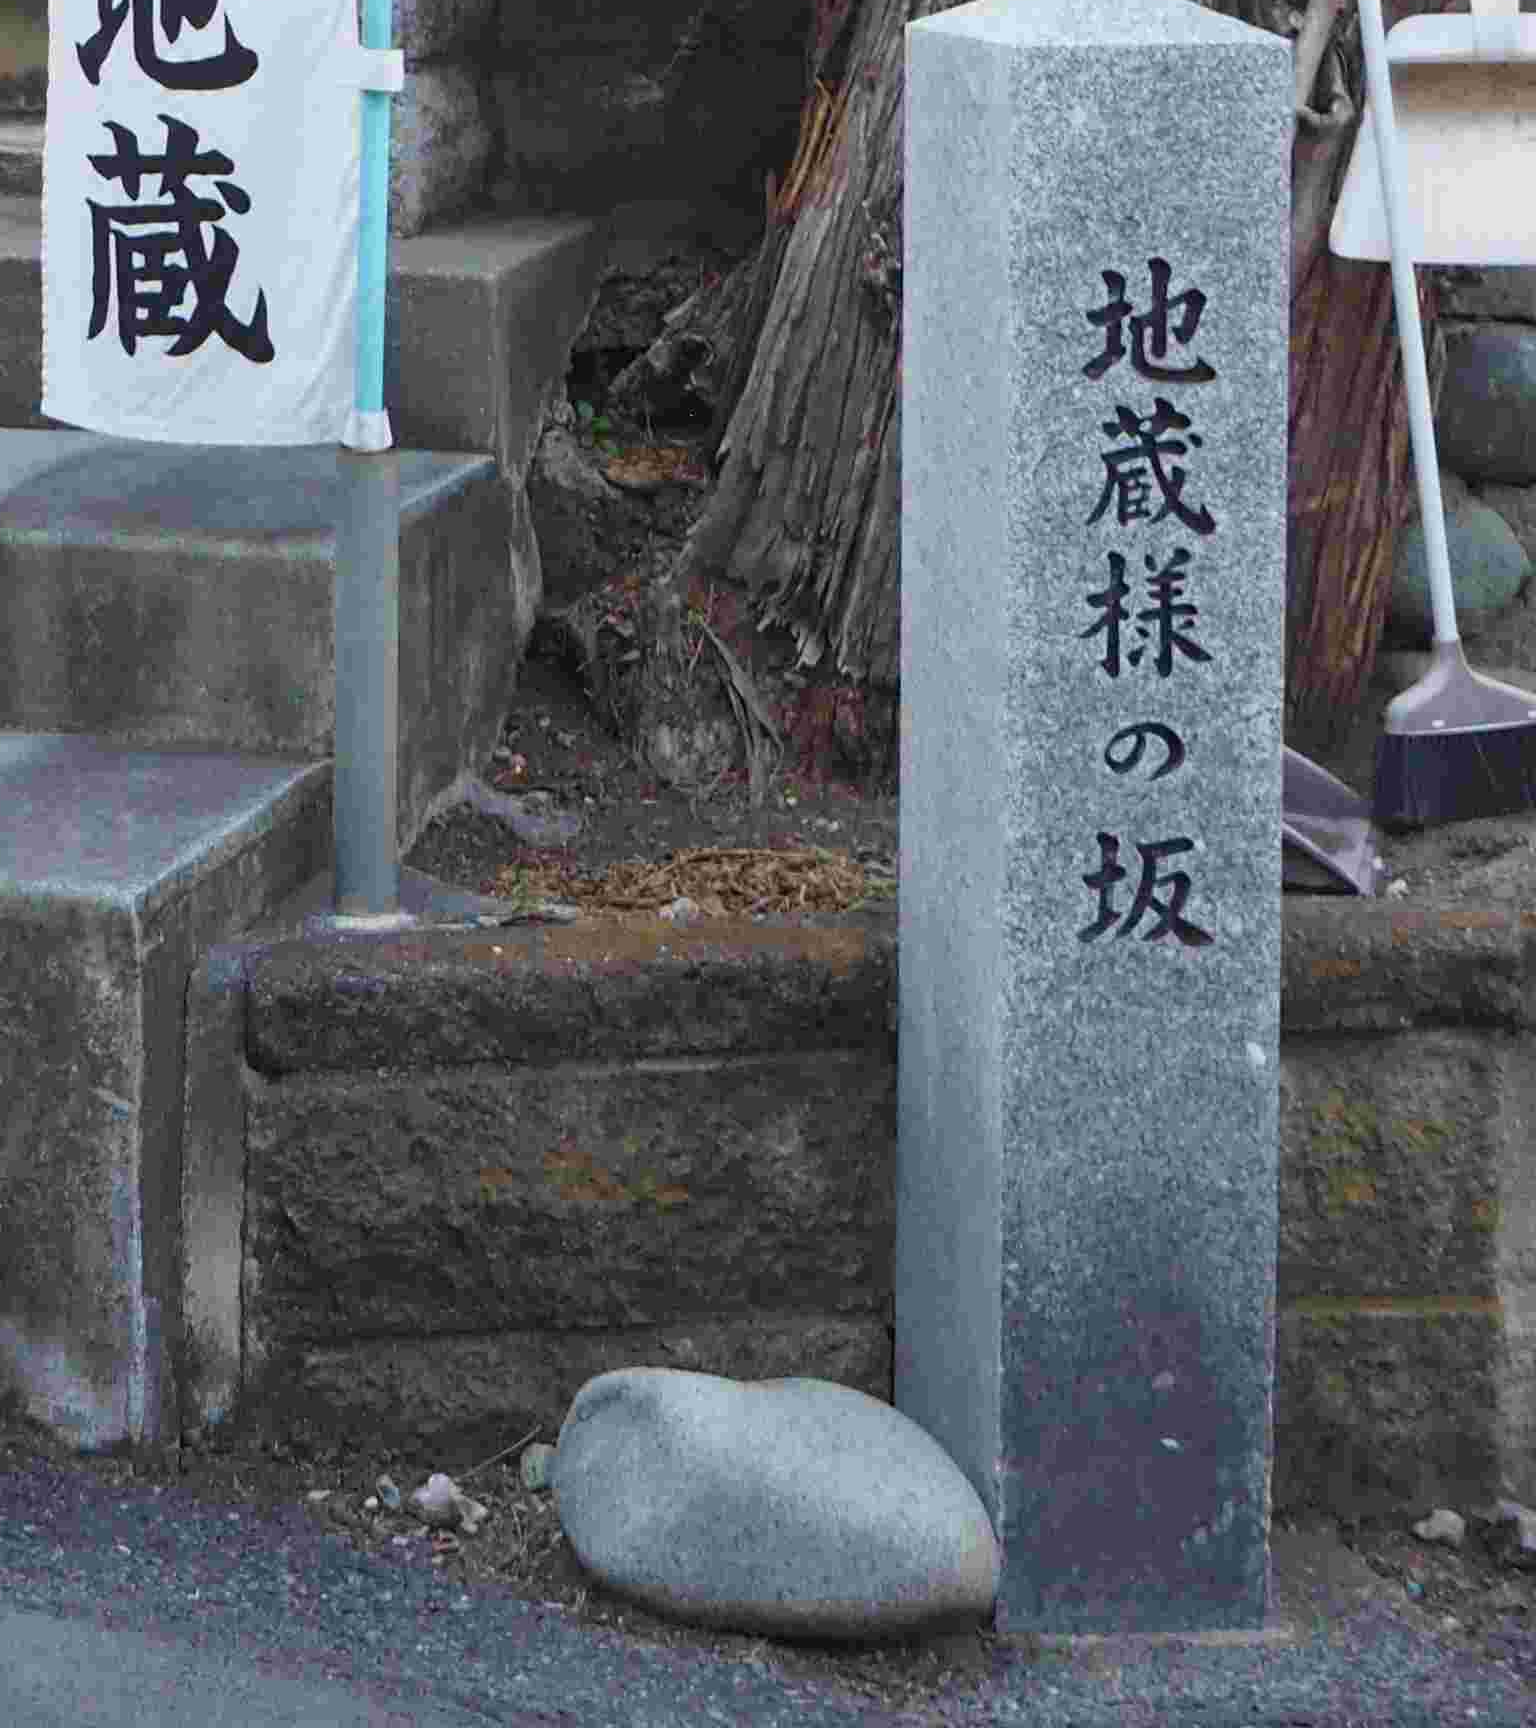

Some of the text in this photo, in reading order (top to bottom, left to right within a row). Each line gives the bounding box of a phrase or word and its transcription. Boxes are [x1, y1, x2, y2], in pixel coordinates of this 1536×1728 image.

[1076, 256, 1218, 949] 地蔵様の坂
